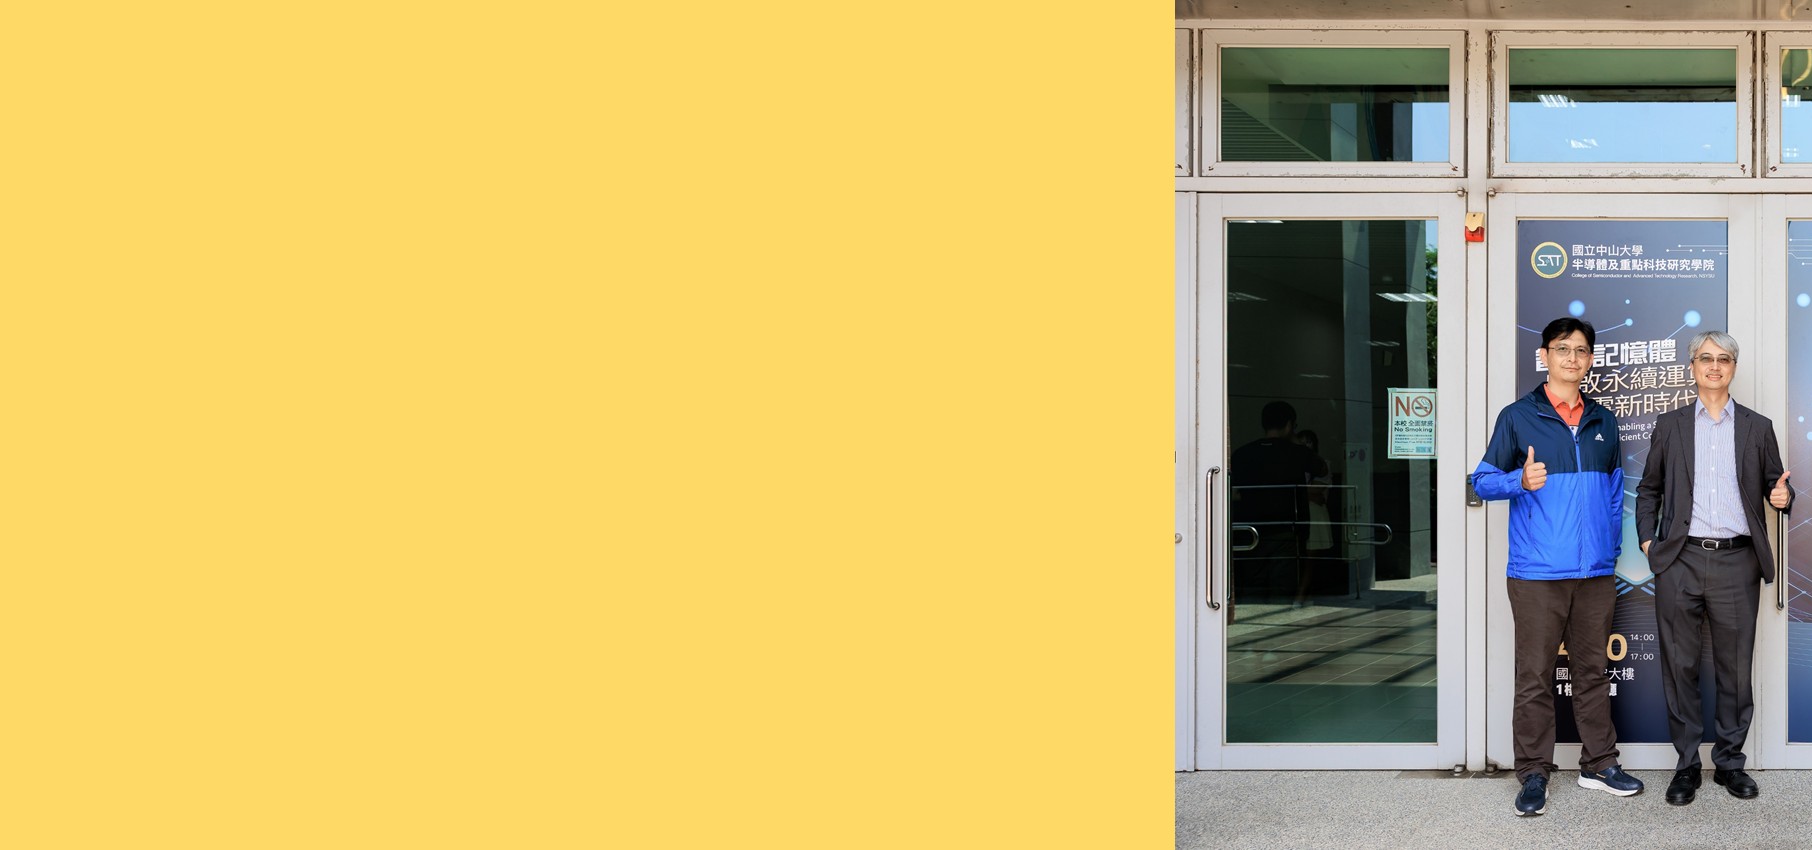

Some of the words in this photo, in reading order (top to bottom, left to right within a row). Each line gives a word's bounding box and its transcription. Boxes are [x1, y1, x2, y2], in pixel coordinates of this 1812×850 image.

[1572, 244, 1643, 256] 國立中山大學
[1572, 258, 1715, 271] 半導體及重點科技研究學院
[1547, 364, 1697, 394] 啟永續運
[1618, 422, 1645, 431] nabling
[1619, 432, 1641, 441] icient
